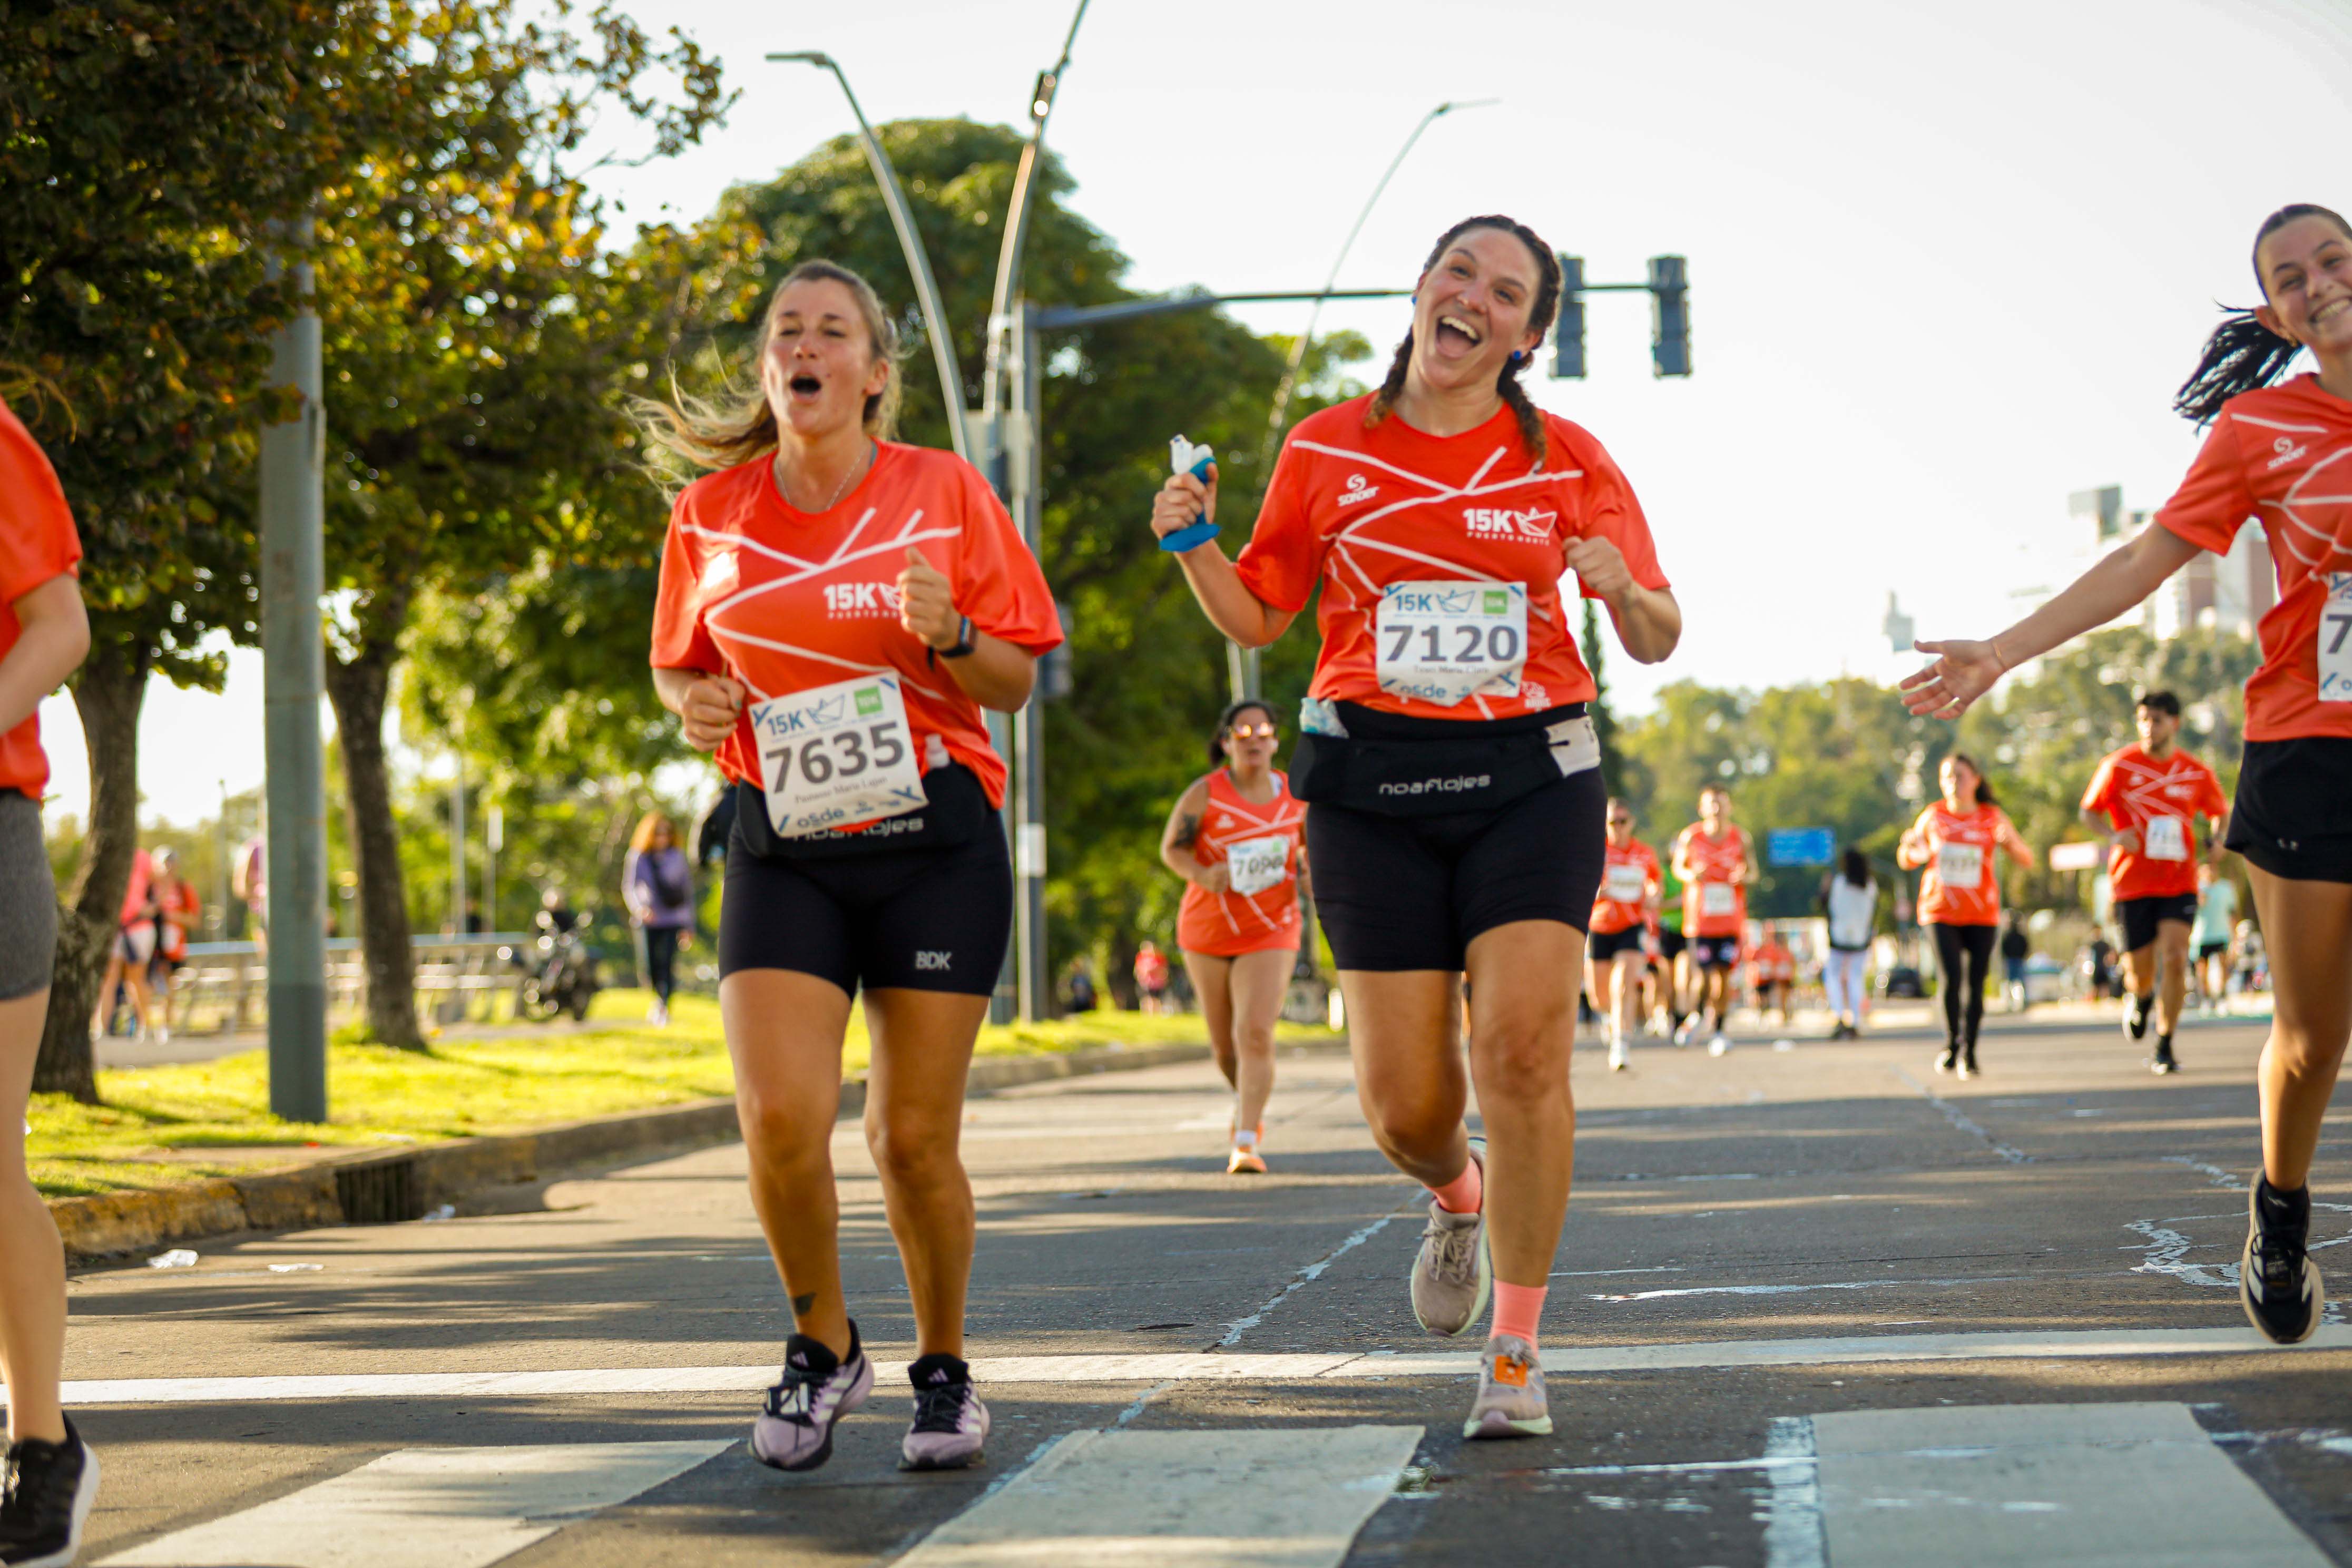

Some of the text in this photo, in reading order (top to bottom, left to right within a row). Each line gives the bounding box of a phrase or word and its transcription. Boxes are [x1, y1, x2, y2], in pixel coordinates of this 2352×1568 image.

[1463, 508, 1514, 533] 15K
[823, 582, 878, 610] 15K
[1395, 594, 1432, 612] 15K
[1384, 624, 1519, 662] 7120
[767, 710, 805, 736] 15K
[766, 721, 905, 794] 7635
[1378, 775, 1491, 795] noaflojes
[916, 950, 952, 971] BDK
